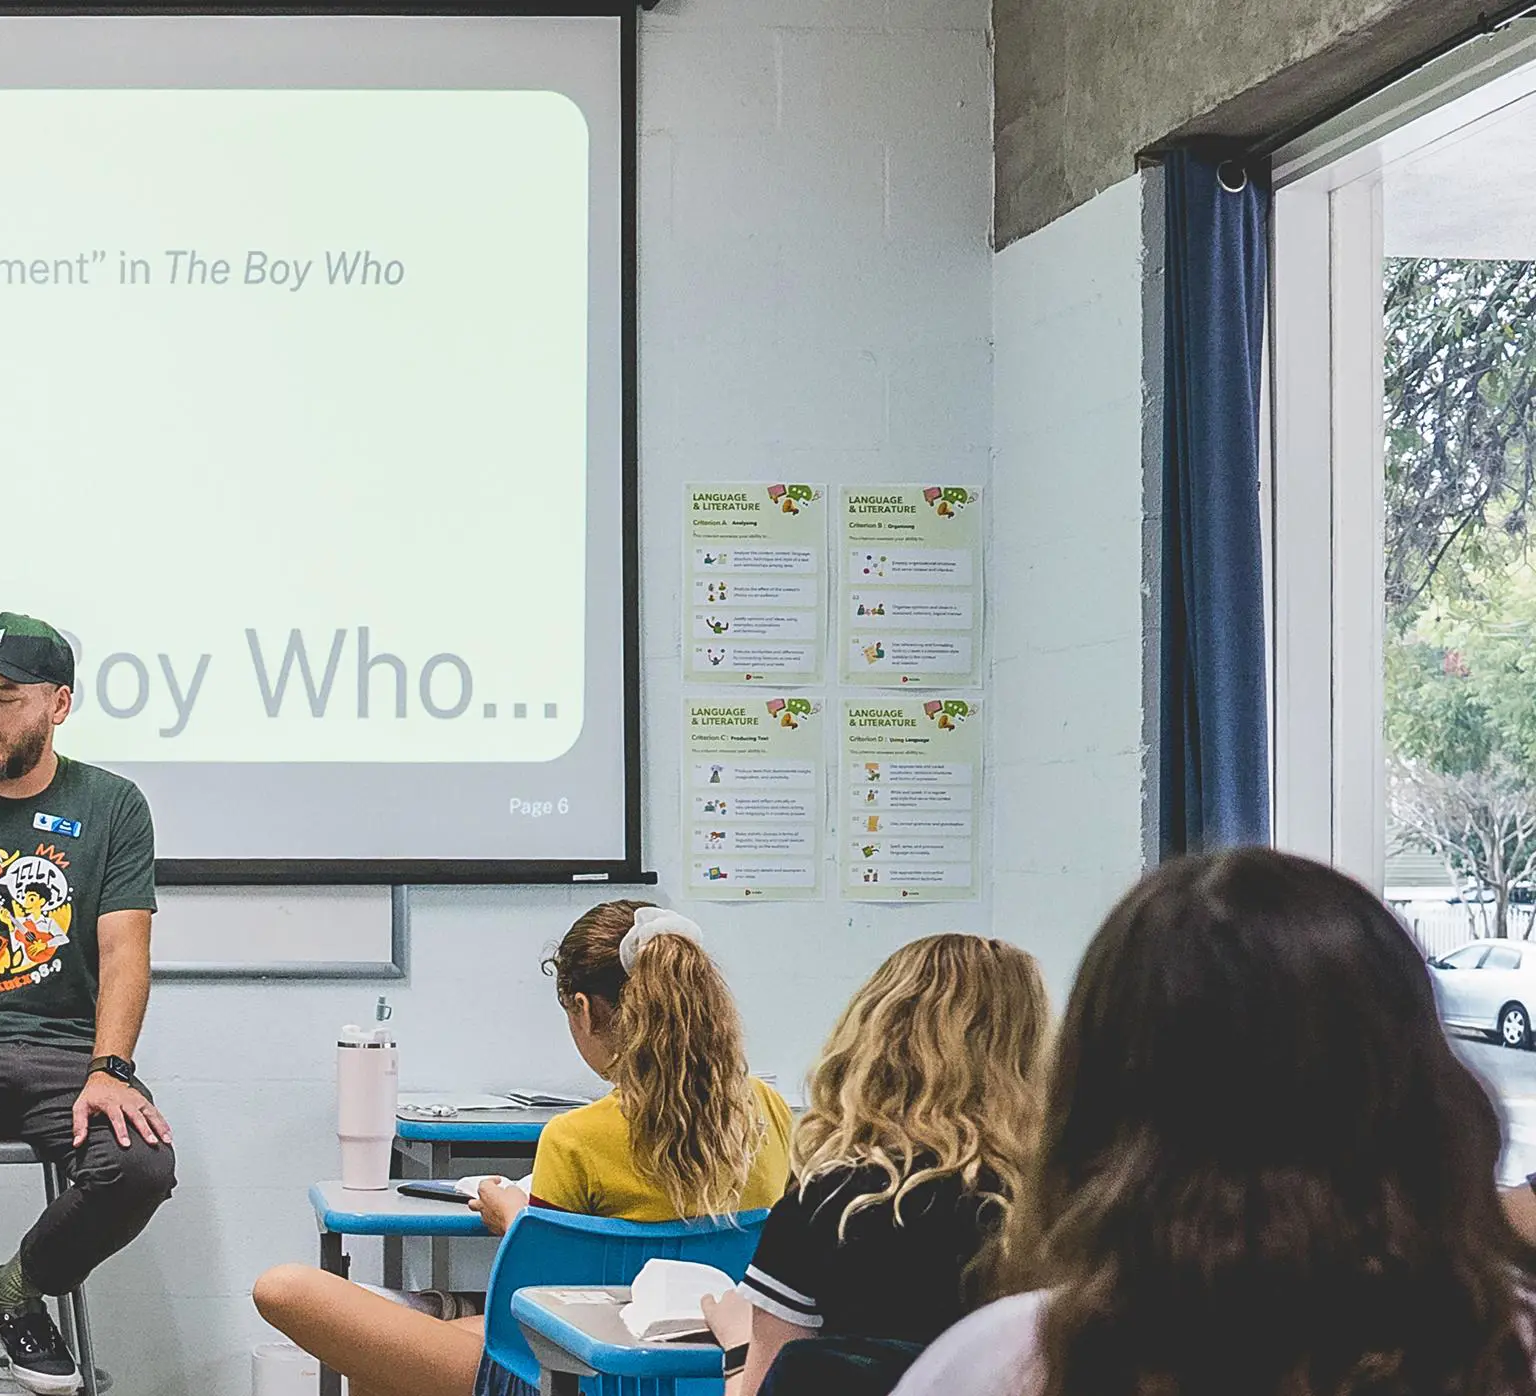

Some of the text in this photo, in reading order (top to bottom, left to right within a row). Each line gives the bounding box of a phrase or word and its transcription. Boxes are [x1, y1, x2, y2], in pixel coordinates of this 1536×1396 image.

[119, 250, 151, 285] in
[164, 250, 231, 285] The
[243, 250, 314, 293] Boy
[324, 250, 405, 286] Who
[693, 493, 747, 502] LANGUAGE
[849, 496, 903, 504] LANGUAGE
[693, 502, 760, 511] & LITERATURE
[859, 505, 916, 513] LITERATURE
[244, 626, 558, 720] Who...
[691, 708, 746, 716] LANGUAGE
[849, 709, 903, 718] LANGUAGE
[691, 717, 759, 726] & LITERATURE
[849, 719, 917, 727] & LITERATURE
[509, 796, 570, 818] Page 6
[30, 958, 62, 984] 98.9
